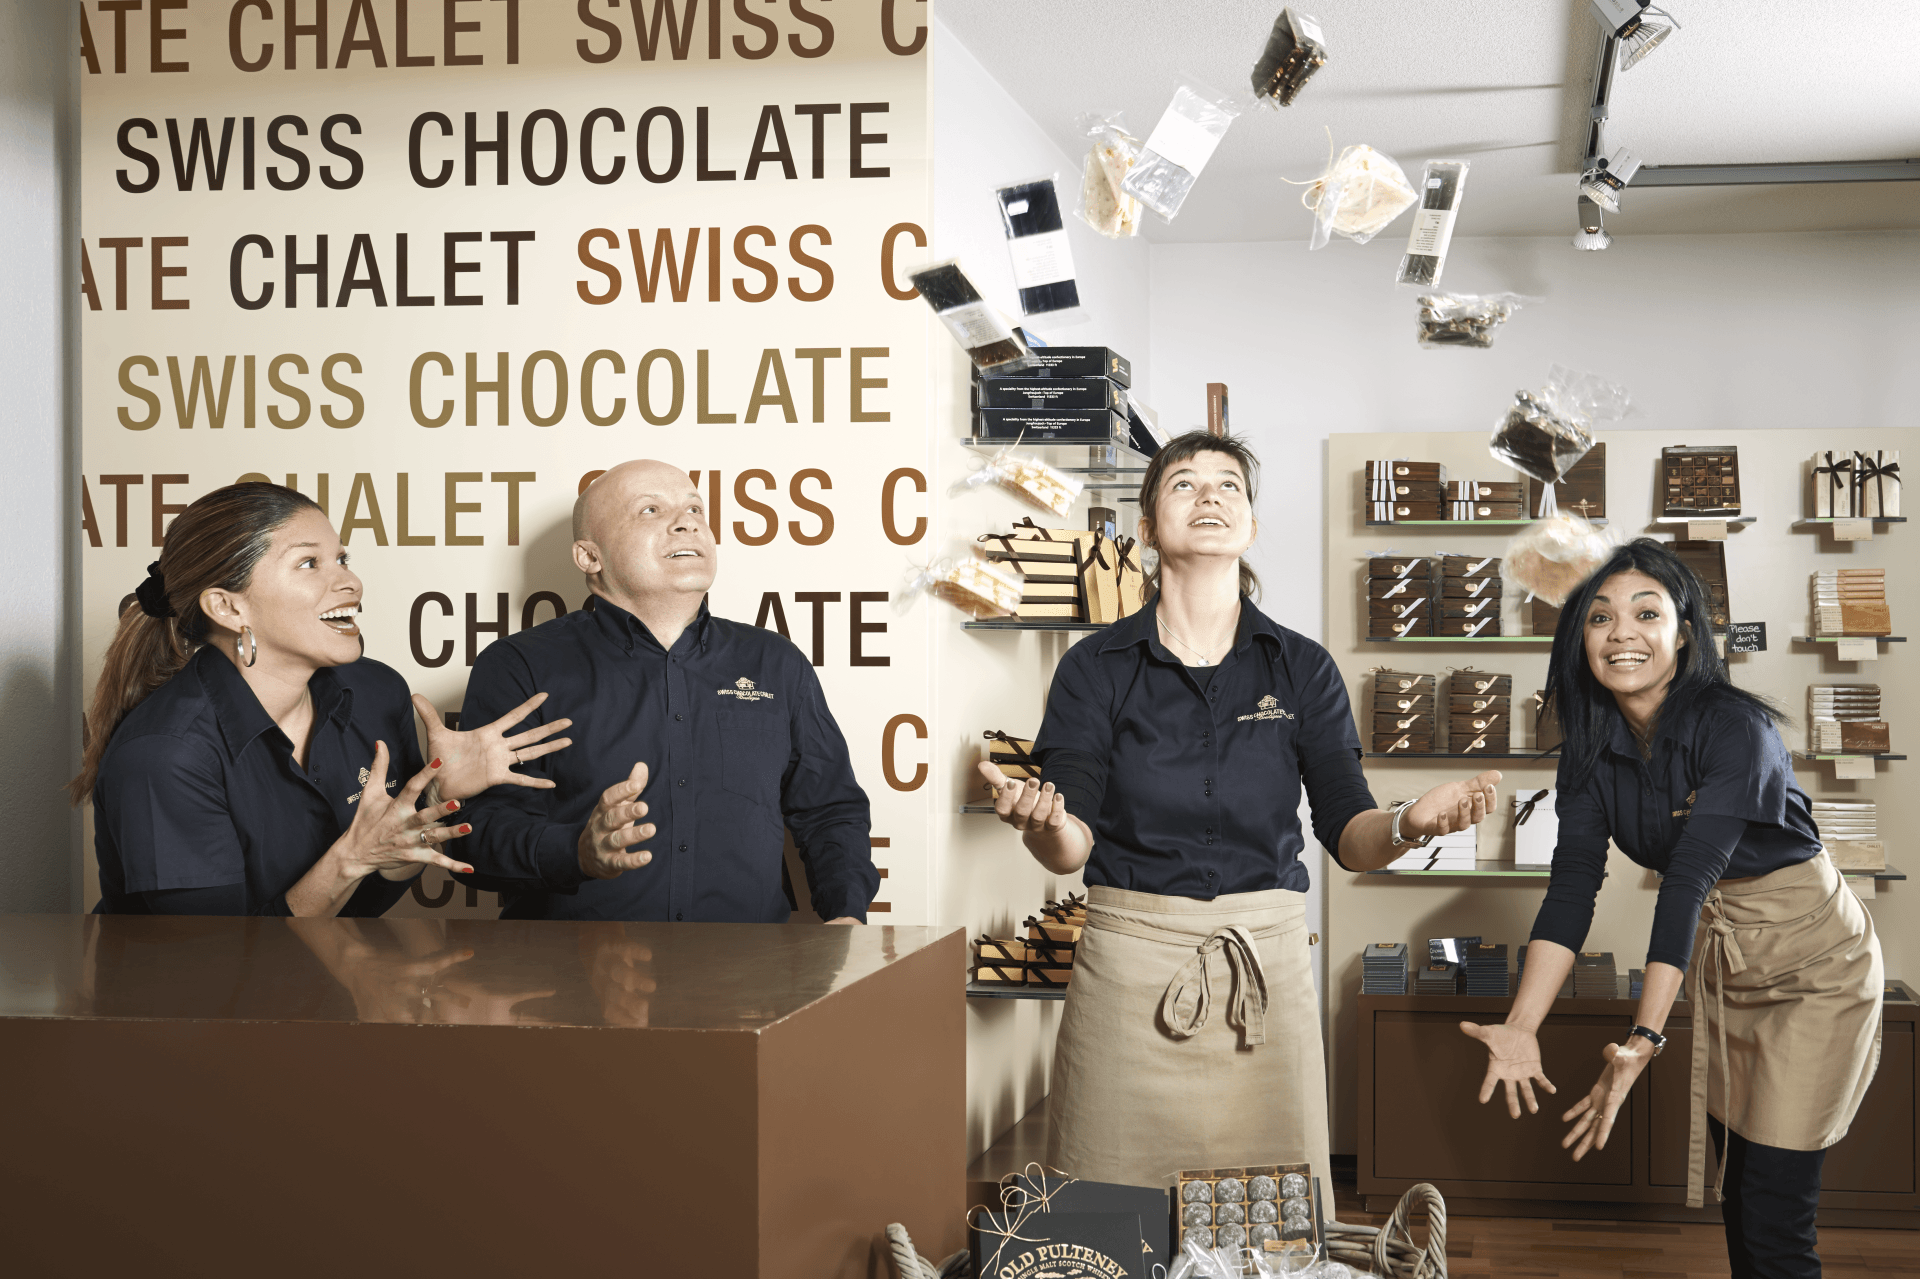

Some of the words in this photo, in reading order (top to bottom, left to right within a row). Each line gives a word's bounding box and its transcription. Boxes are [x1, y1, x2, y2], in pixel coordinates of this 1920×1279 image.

[229, 0, 522, 73] CHALET
[576, 0, 835, 64] SWISS
[115, 115, 364, 194] SWISS
[408, 102, 891, 189] CHOCOLATE
[229, 231, 536, 310] CHALET
[576, 225, 835, 305] SWISS
[116, 353, 365, 431] SWISS
[409, 347, 891, 429] CHOCOLATE
[234, 471, 536, 547] ALET
[577, 468, 835, 547] ISS
[1729, 624, 1761, 633] Please
[1732, 643, 1758, 653] touch
[1736, 634, 1758, 642] don't
[999, 1251, 1035, 1279] OLD
[1035, 1243, 1128, 1279] PULTENEY
[1038, 1260, 1057, 1271] MALT
[1058, 1260, 1086, 1270] SCOTCH
